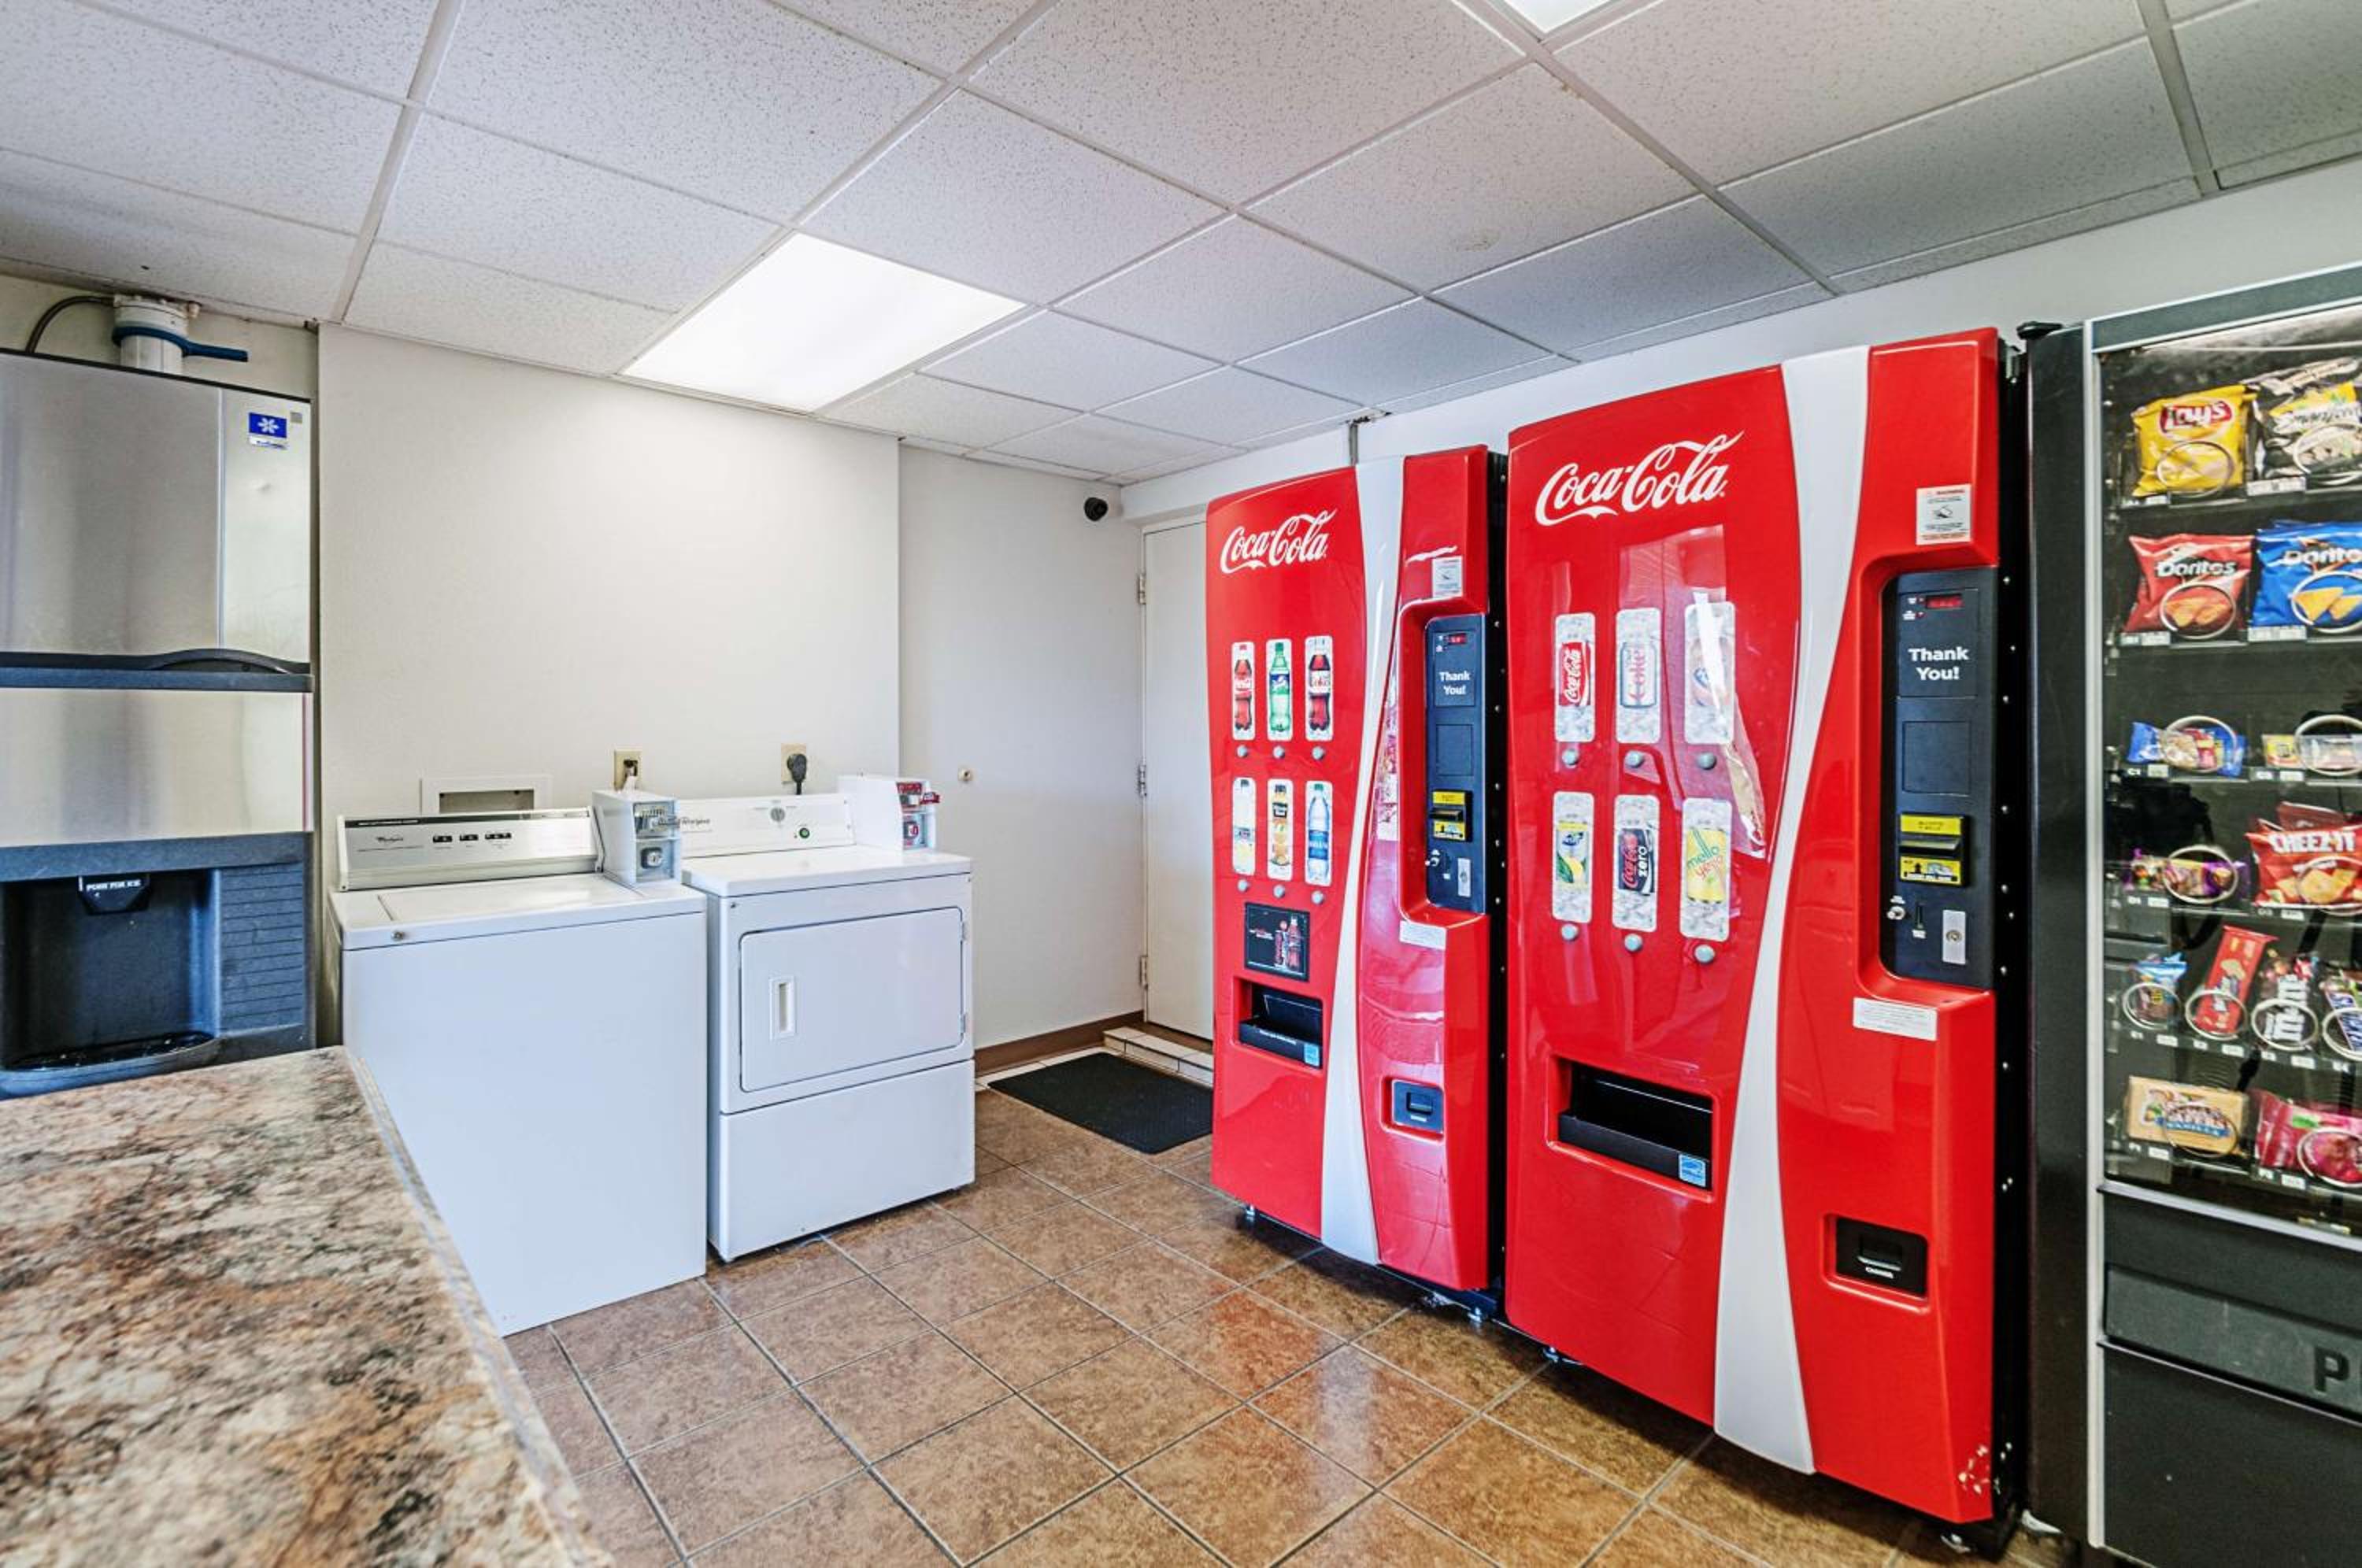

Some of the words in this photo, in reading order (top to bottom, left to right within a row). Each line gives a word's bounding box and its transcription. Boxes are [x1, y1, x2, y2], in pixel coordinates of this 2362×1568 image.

[1535, 430, 1745, 527] Coca-Cola
[1220, 508, 1338, 574] Coca-Cola
[2282, 546, 2362, 568] Dorito
[2155, 560, 2237, 578] Doritos
[1908, 646, 1969, 662] Thank
[1438, 670, 1471, 682] Thank
[1916, 666, 1960, 681] You!
[1443, 684, 1466, 696] You!
[1638, 846, 1648, 877] zero
